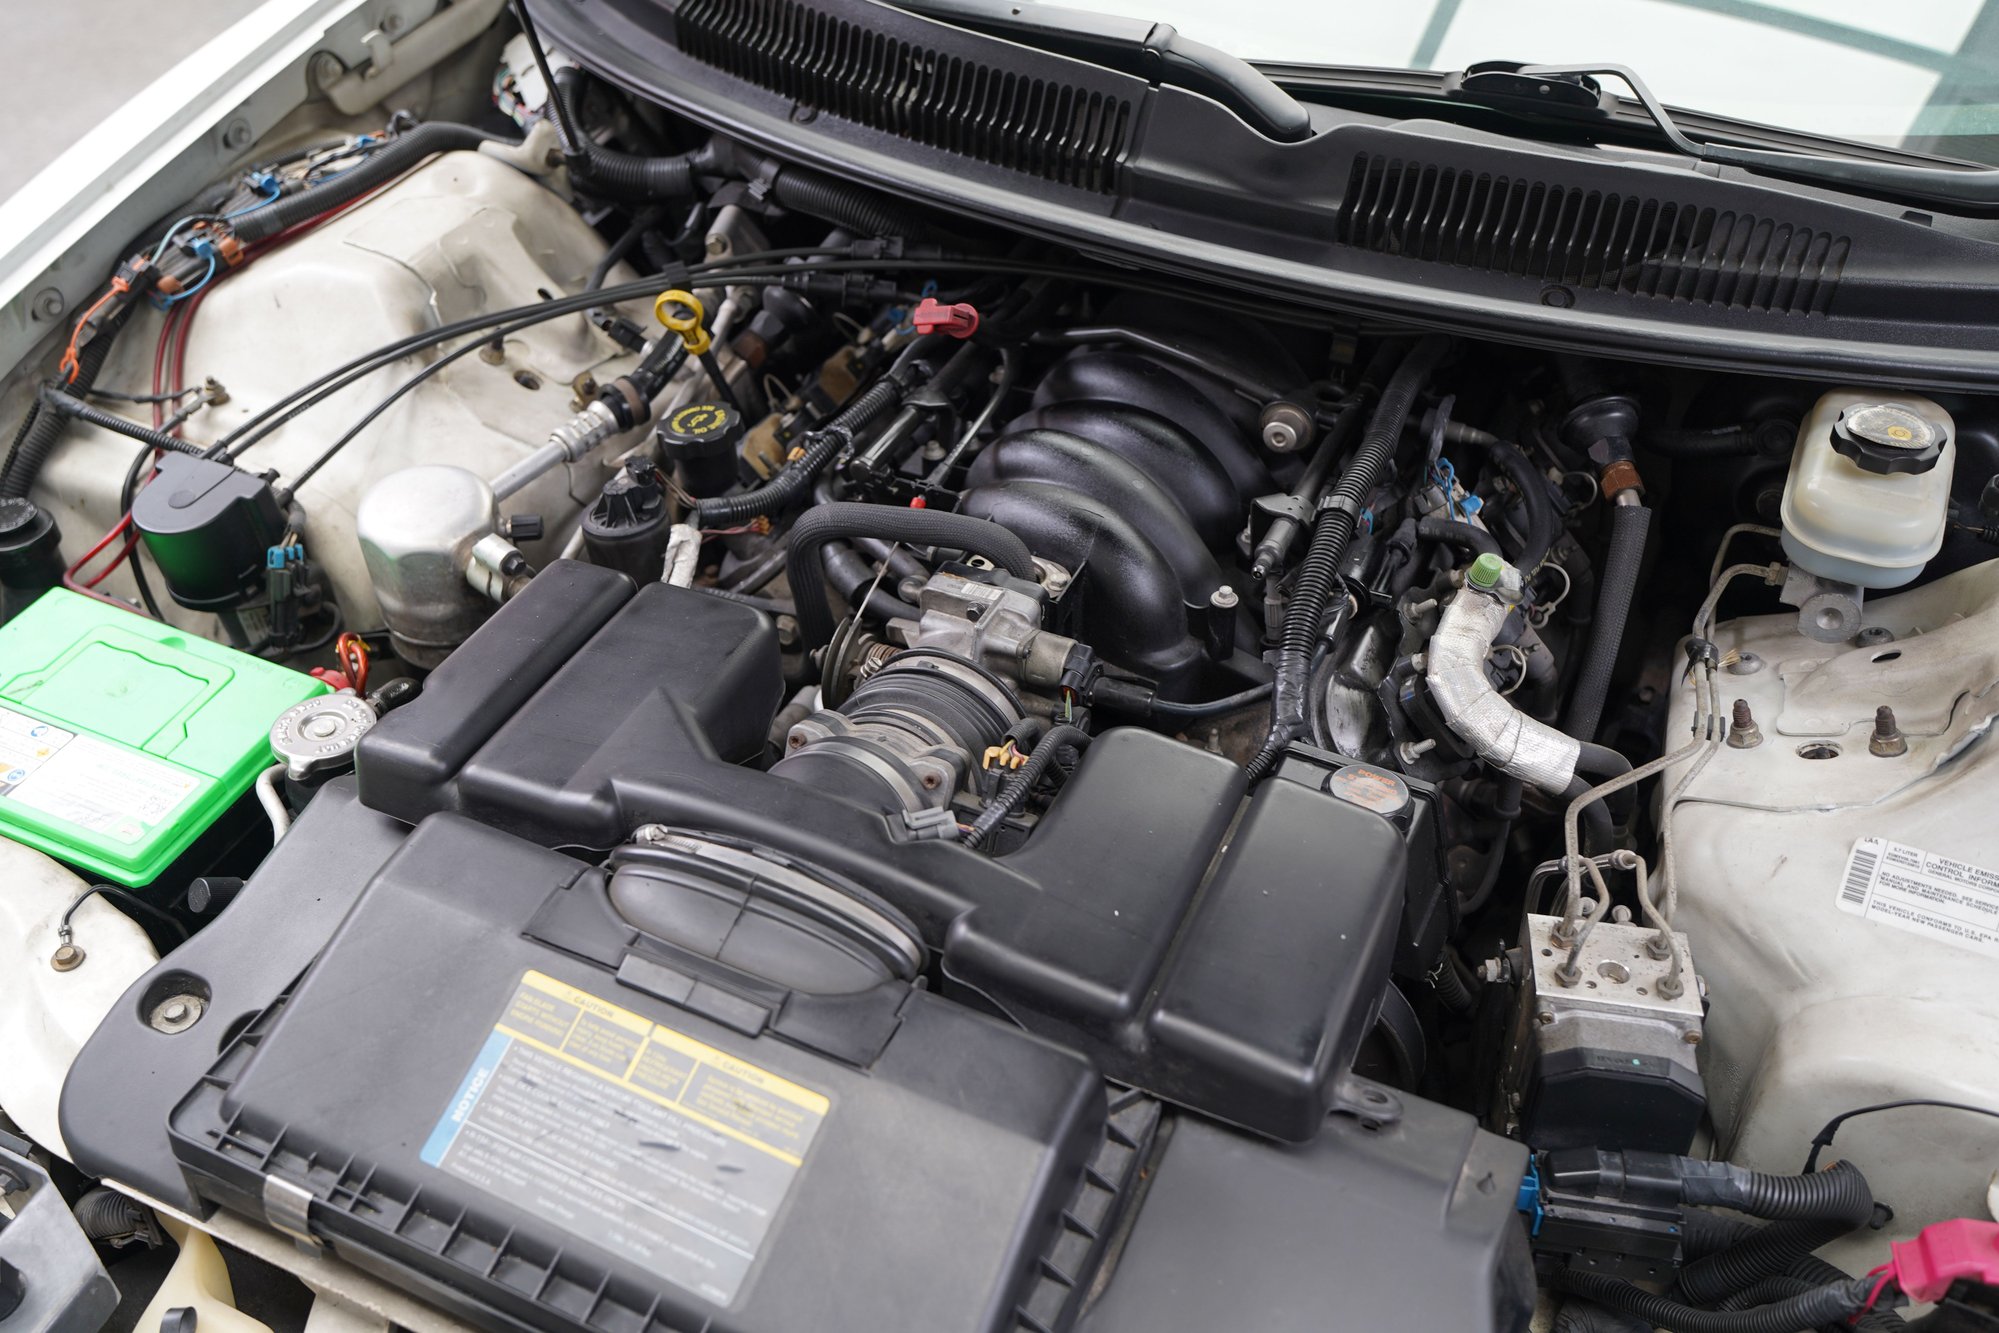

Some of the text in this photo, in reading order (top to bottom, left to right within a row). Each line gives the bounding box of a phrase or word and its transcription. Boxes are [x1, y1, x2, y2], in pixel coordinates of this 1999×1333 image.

[1357, 768, 1396, 787] POWER
[1901, 849, 1917, 857] LITER
[1925, 861, 1964, 877] CONTROL
[1938, 858, 1973, 873] VEHICLE
[1891, 874, 1932, 890] ADJUSTMENTS
[1927, 869, 1953, 880] GENERAL
[1880, 876, 1903, 886] MANUAL
[1921, 888, 1963, 904] MAINTENANCE
[1890, 884, 1907, 892] MORE
[1872, 900, 1886, 908] THIS
[1888, 905, 1915, 916] VEHICLE
[1916, 913, 1952, 928] CONFORMS
[1926, 921, 1963, 936] PASSENGER
[572, 994, 615, 1018] CAUTION
[721, 1060, 765, 1084] CAUTION
[450, 1068, 489, 1123] NOTICE
